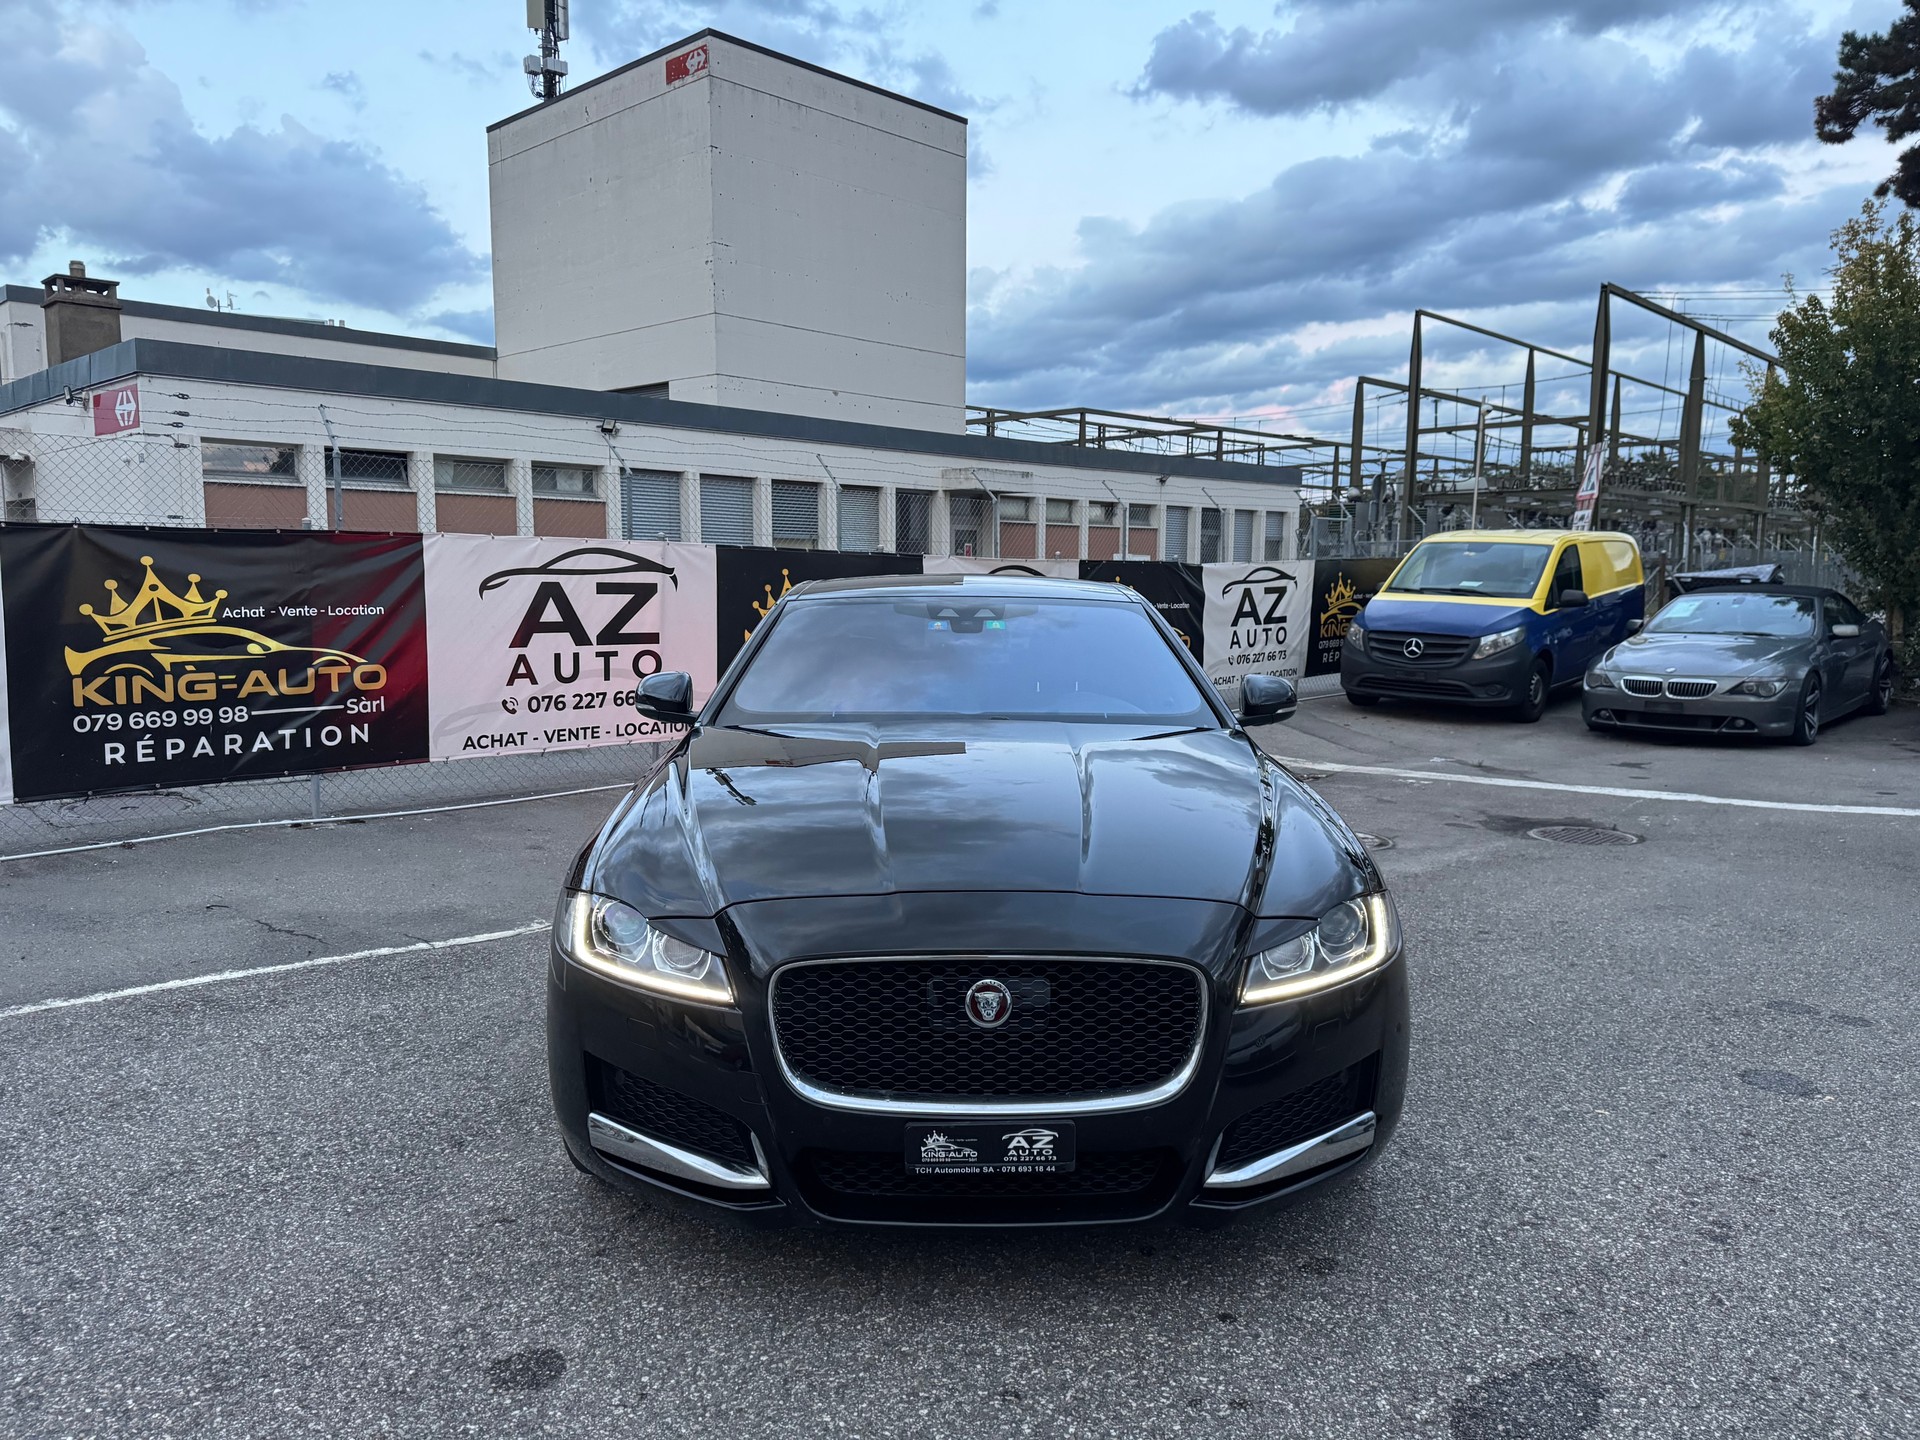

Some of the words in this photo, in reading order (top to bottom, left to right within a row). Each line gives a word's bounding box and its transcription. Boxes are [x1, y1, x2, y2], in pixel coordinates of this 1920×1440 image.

[222, 606, 265, 618] Achat
[279, 605, 318, 617] Vente
[328, 604, 384, 616] Location
[509, 581, 660, 648] AZ
[1230, 586, 1287, 627] AZ
[1230, 626, 1287, 650] AUTO
[506, 650, 662, 686] AUTO
[1237, 654, 1250, 665] 076
[1252, 652, 1265, 663] 227
[1267, 651, 1276, 661] 66
[1278, 650, 1286, 660] 73
[1213, 676, 1235, 685] ACHAT
[346, 696, 384, 714] Sàrl
[528, 694, 566, 714] 076
[572, 692, 606, 710] 227
[613, 690, 636, 707] 66
[73, 714, 122, 733] 079
[129, 710, 177, 729] 669
[183, 709, 214, 726] 99
[219, 706, 248, 724] 98
[104, 723, 370, 765] RÉPARATION
[462, 730, 528, 750] ACHAT
[544, 726, 600, 744] VENTE
[1008, 1136, 1053, 1148] AZ
